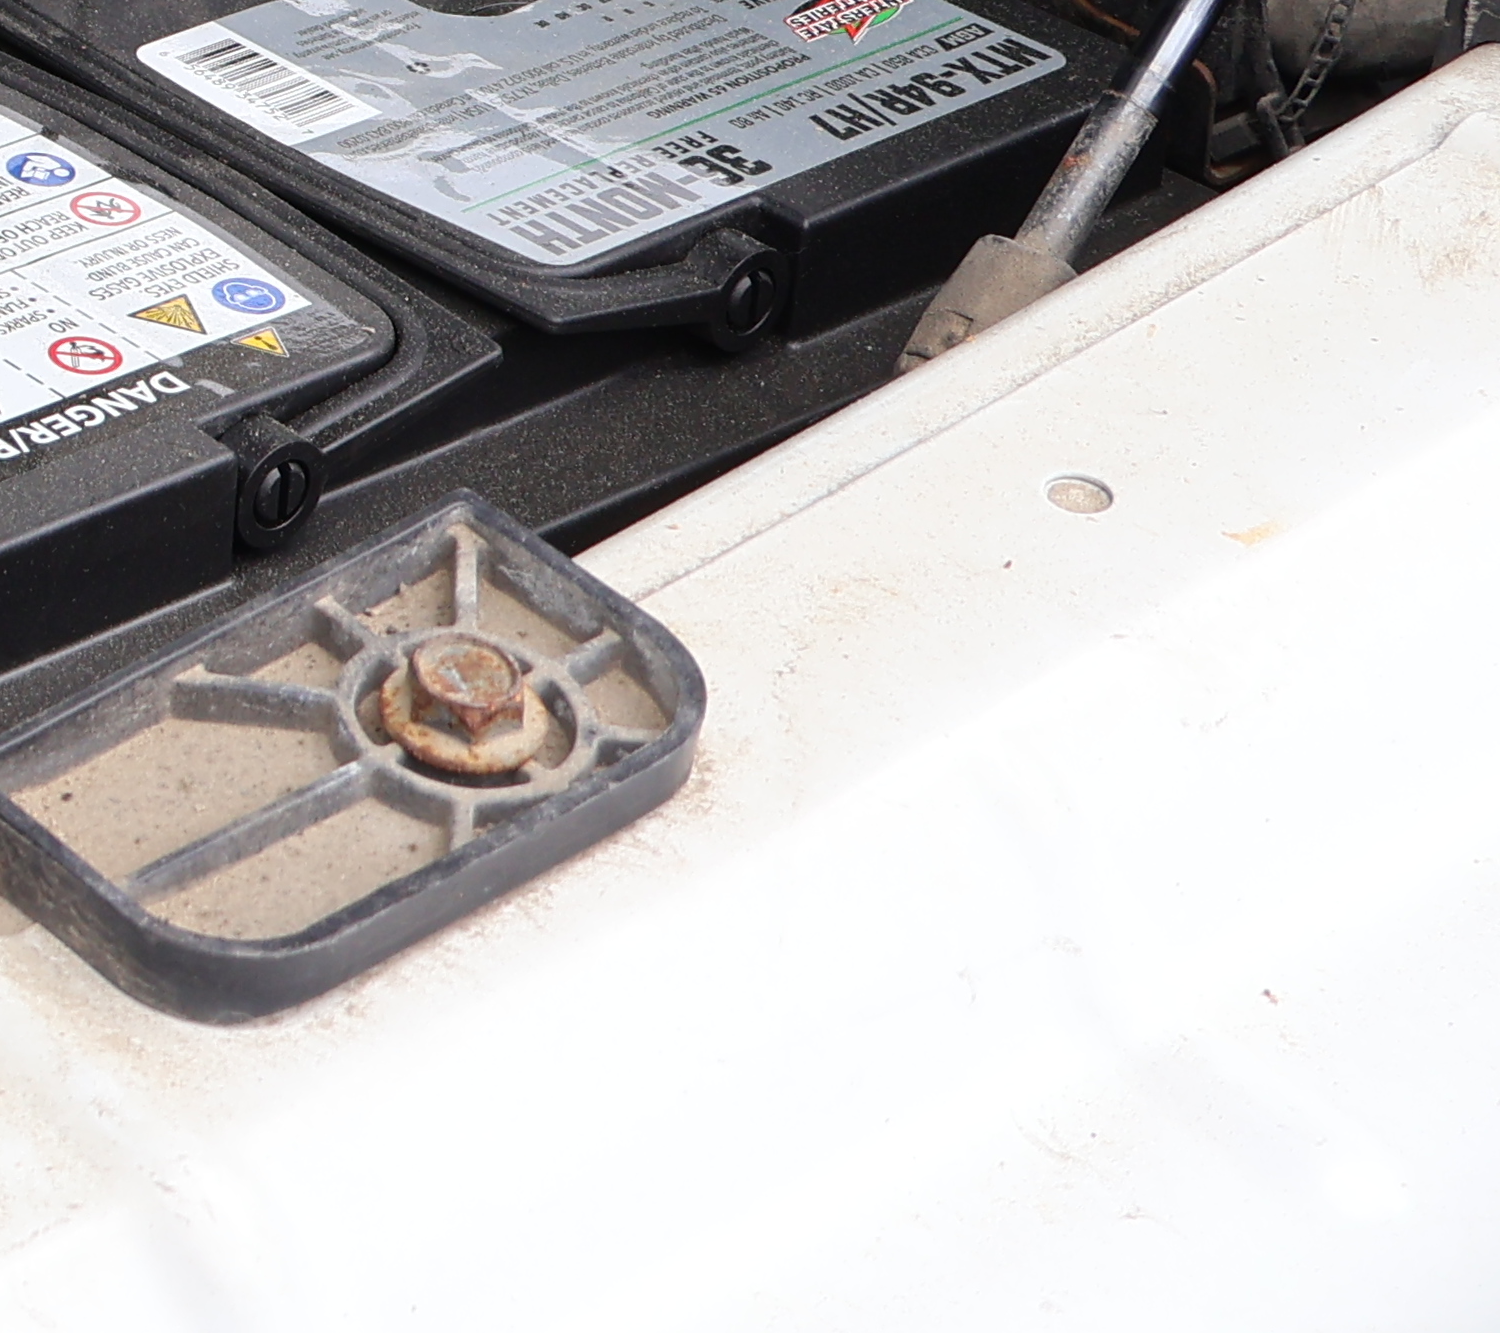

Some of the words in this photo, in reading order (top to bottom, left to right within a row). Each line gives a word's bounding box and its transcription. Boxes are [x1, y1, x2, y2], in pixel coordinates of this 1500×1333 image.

[936, 25, 991, 47] AGM
[878, 53, 917, 69] 850
[902, 43, 942, 60] CCA
[721, 52, 813, 89] PROPOSITION
[851, 66, 884, 80] CA
[705, 84, 730, 95] 65
[791, 33, 1060, 144] MTX-94R/H7
[820, 73, 866, 92] 1000
[643, 91, 713, 119] WARNING
[771, 96, 807, 111] 140
[794, 88, 826, 102] RC
[725, 115, 757, 130] 80
[744, 108, 774, 122] Ah
[650, 130, 720, 160] FREE
[481, 154, 658, 227] REPLACEMENT
[506, 142, 777, 257] 36-MONTH
[13, 209, 70, 234] REACH
[43, 220, 88, 240] KEEP
[10, 233, 51, 252] OUT
[121, 237, 149, 251] OR
[141, 225, 183, 244] NESS
[165, 236, 201, 253] CAN
[71, 244, 129, 269] INJURY.
[125, 246, 174, 267] CAUSE
[134, 247, 221, 283] EXPLOSIVE
[80, 261, 133, 284] BLIND-
[179, 257, 240, 284] SHIELD
[85, 275, 144, 301] GASES
[137, 277, 186, 300] EYES.
[45, 317, 79, 334] NO
